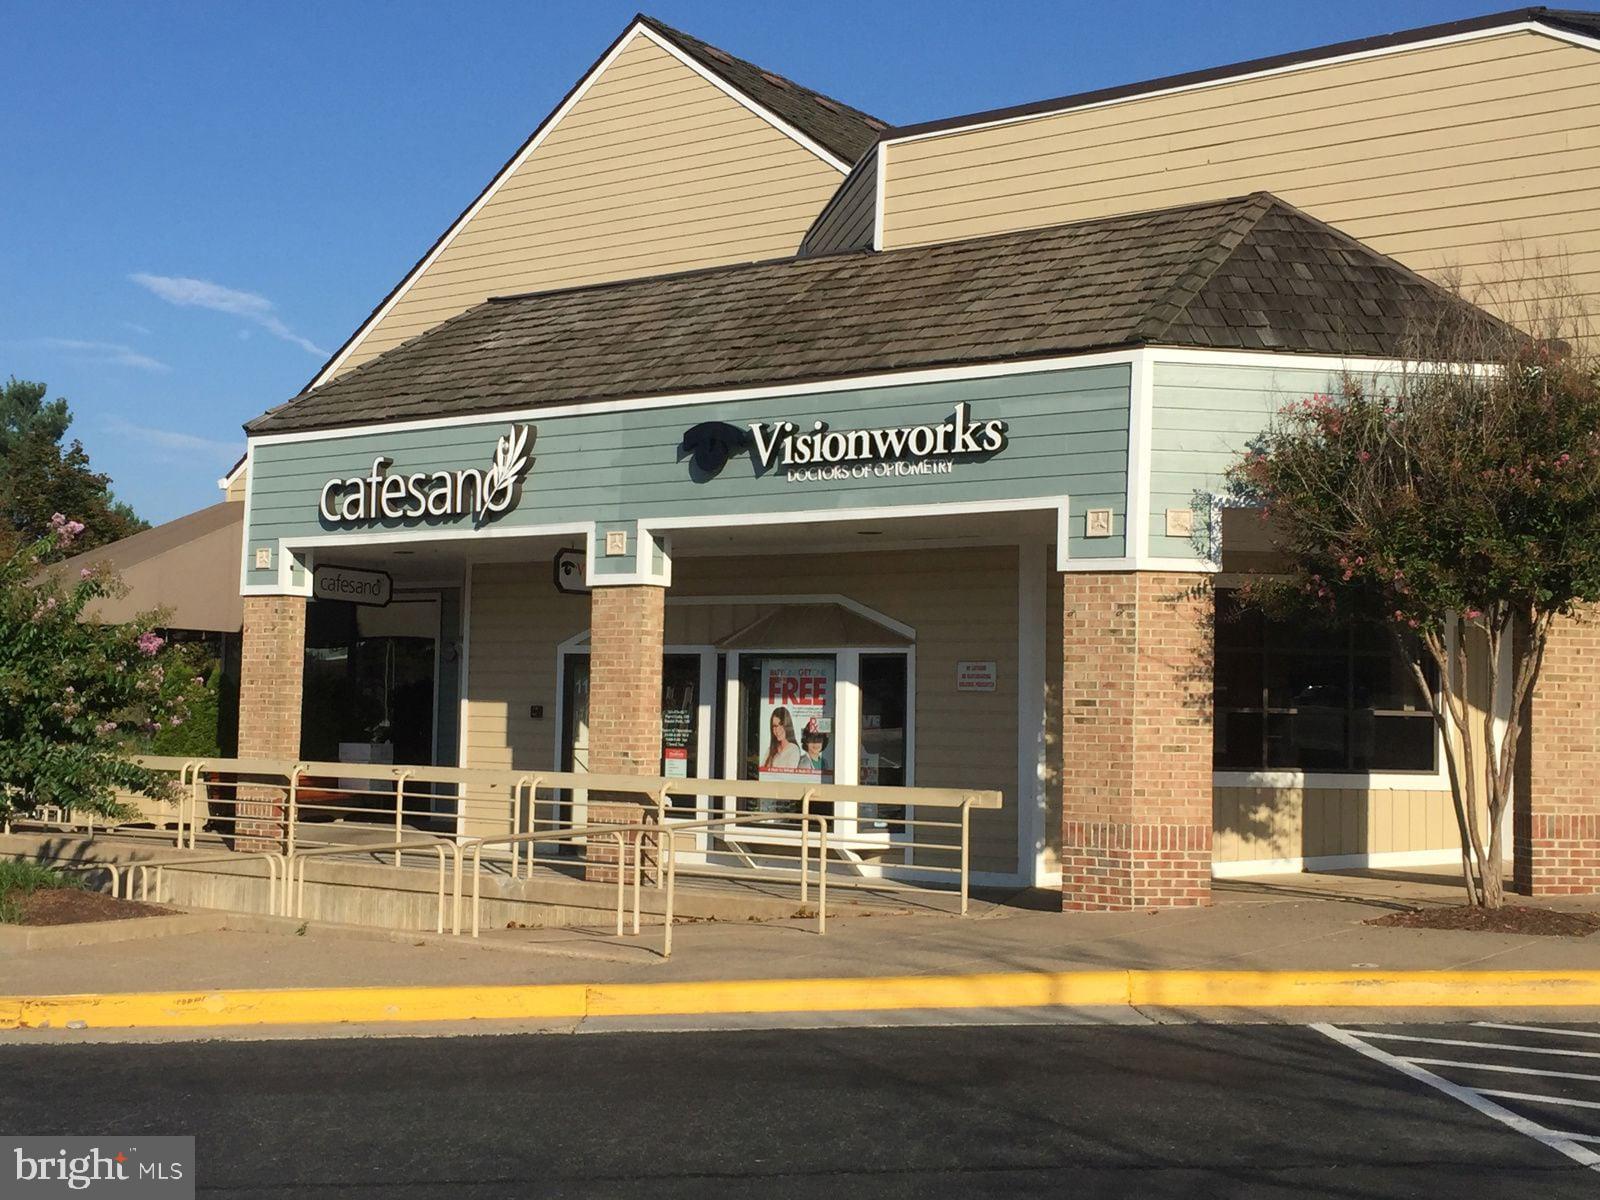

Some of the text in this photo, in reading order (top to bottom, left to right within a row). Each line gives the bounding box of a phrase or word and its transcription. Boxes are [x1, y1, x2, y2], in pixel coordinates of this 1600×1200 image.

[748, 401, 1004, 467] Visionworks
[787, 458, 954, 482] DOCTORS OF OPTOMETRY
[319, 455, 515, 522] cafesano
[320, 573, 381, 596] cafesano
[768, 676, 827, 705] FREE
